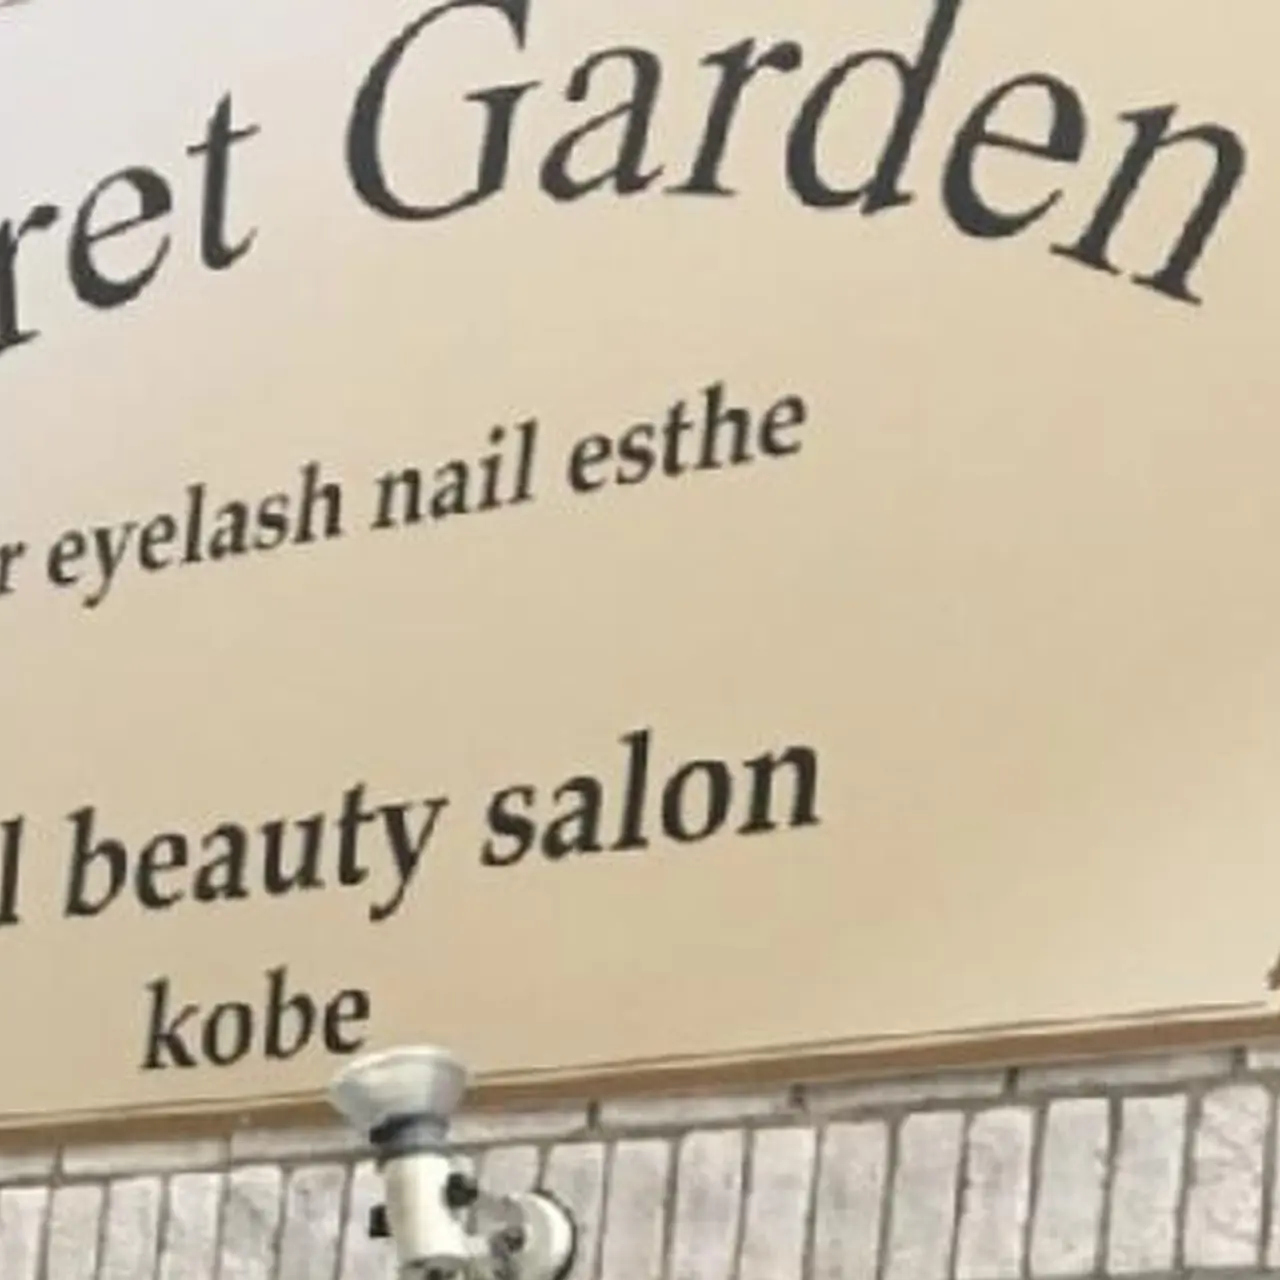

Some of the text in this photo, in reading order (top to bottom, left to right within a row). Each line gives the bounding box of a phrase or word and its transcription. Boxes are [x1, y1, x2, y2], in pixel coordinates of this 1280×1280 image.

[346, 0, 1246, 305] Garden
[46, 462, 342, 609] eyelash
[370, 419, 538, 530] nail
[567, 382, 807, 495] esthe
[64, 783, 450, 923] beauty
[479, 728, 820, 868] salon
[141, 965, 371, 1070] kobe
